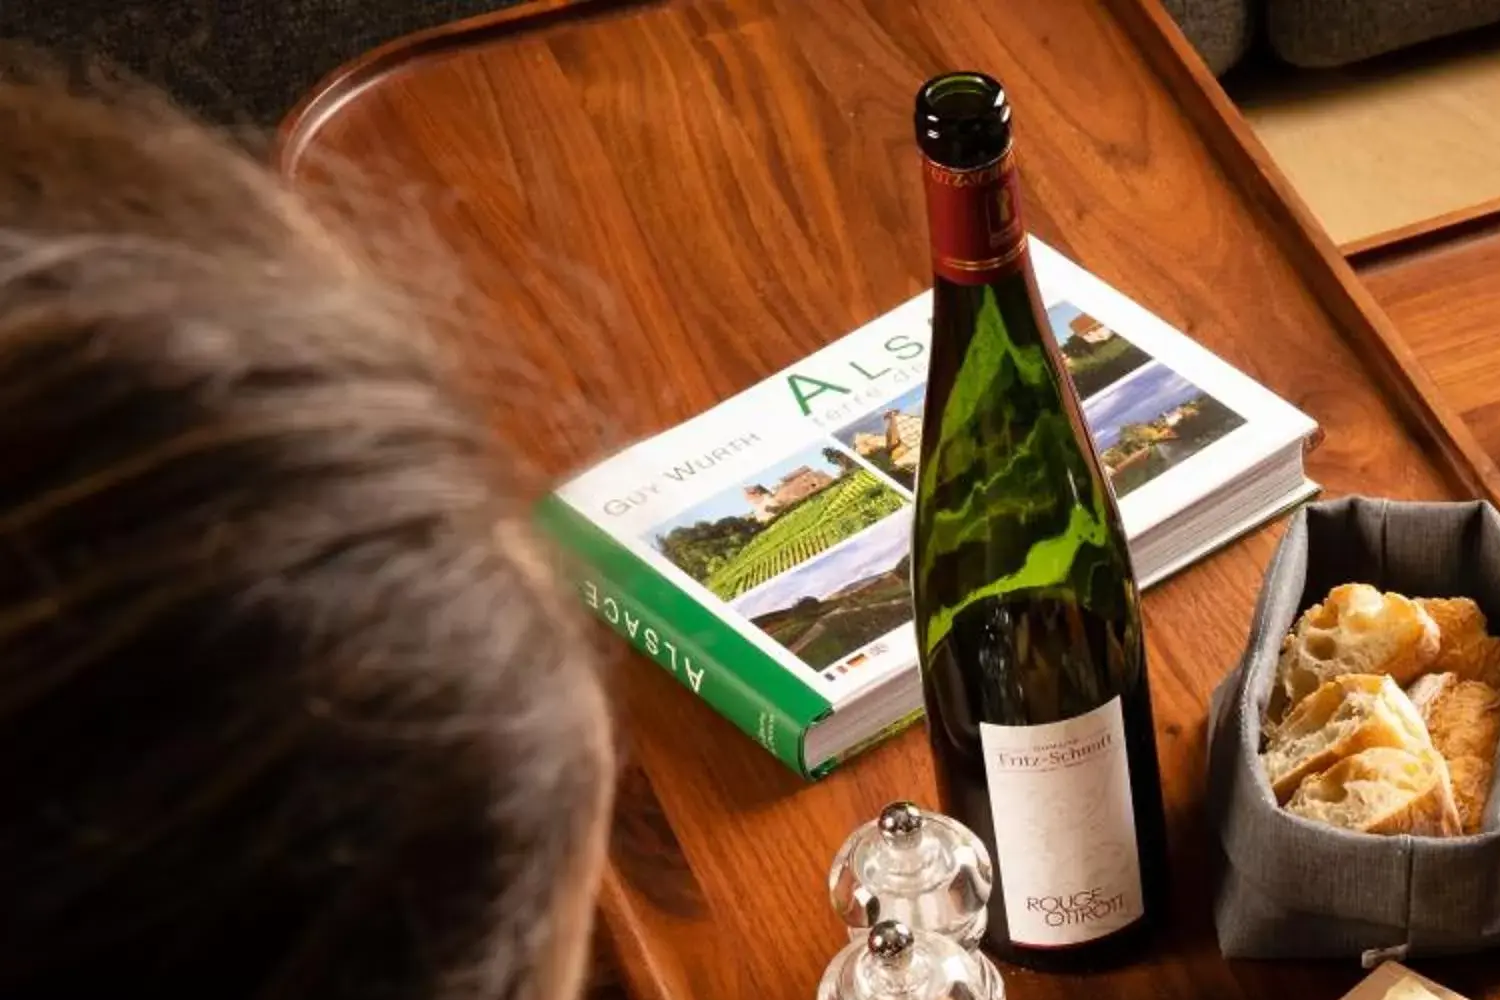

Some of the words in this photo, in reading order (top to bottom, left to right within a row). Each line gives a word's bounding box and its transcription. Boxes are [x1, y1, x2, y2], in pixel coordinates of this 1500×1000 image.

[786, 317, 934, 417] ALS
[602, 482, 661, 517] GUY
[662, 431, 763, 482] WURTH
[583, 579, 705, 694] ALSACE
[1026, 887, 1104, 912] ROUGE
